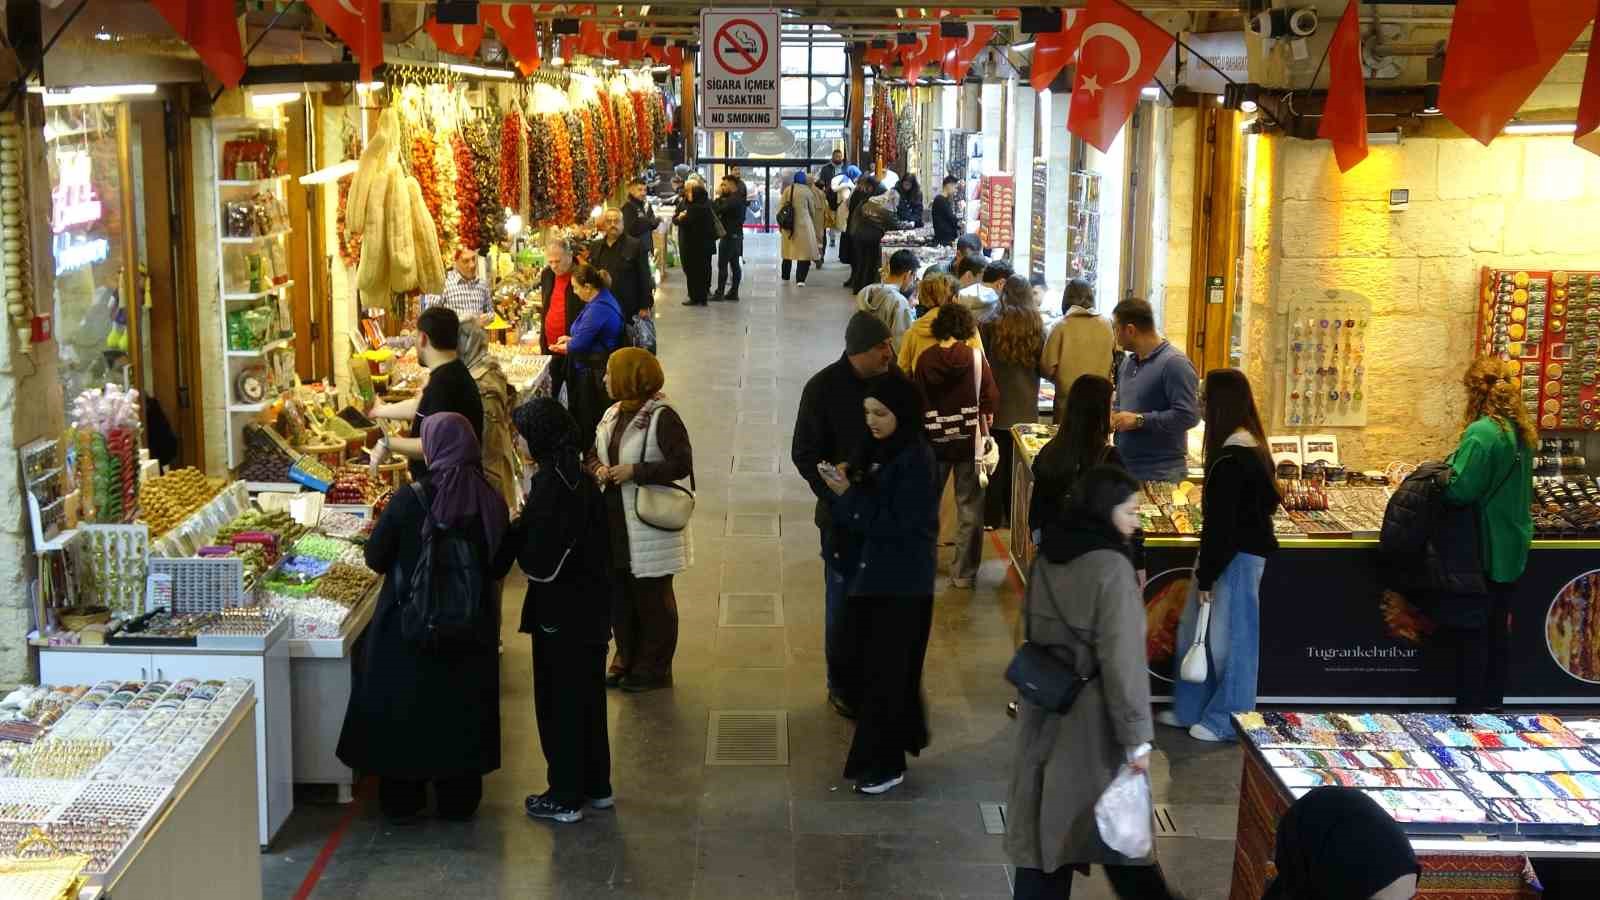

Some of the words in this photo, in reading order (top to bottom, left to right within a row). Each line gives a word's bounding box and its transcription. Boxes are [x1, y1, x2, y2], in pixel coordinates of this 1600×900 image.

[706, 77, 741, 90] SİGARA
[744, 77, 775, 93] İÇMEK
[717, 94, 766, 105] YASAKTIR!
[711, 113, 725, 123] NO
[727, 113, 771, 123] SMOKING
